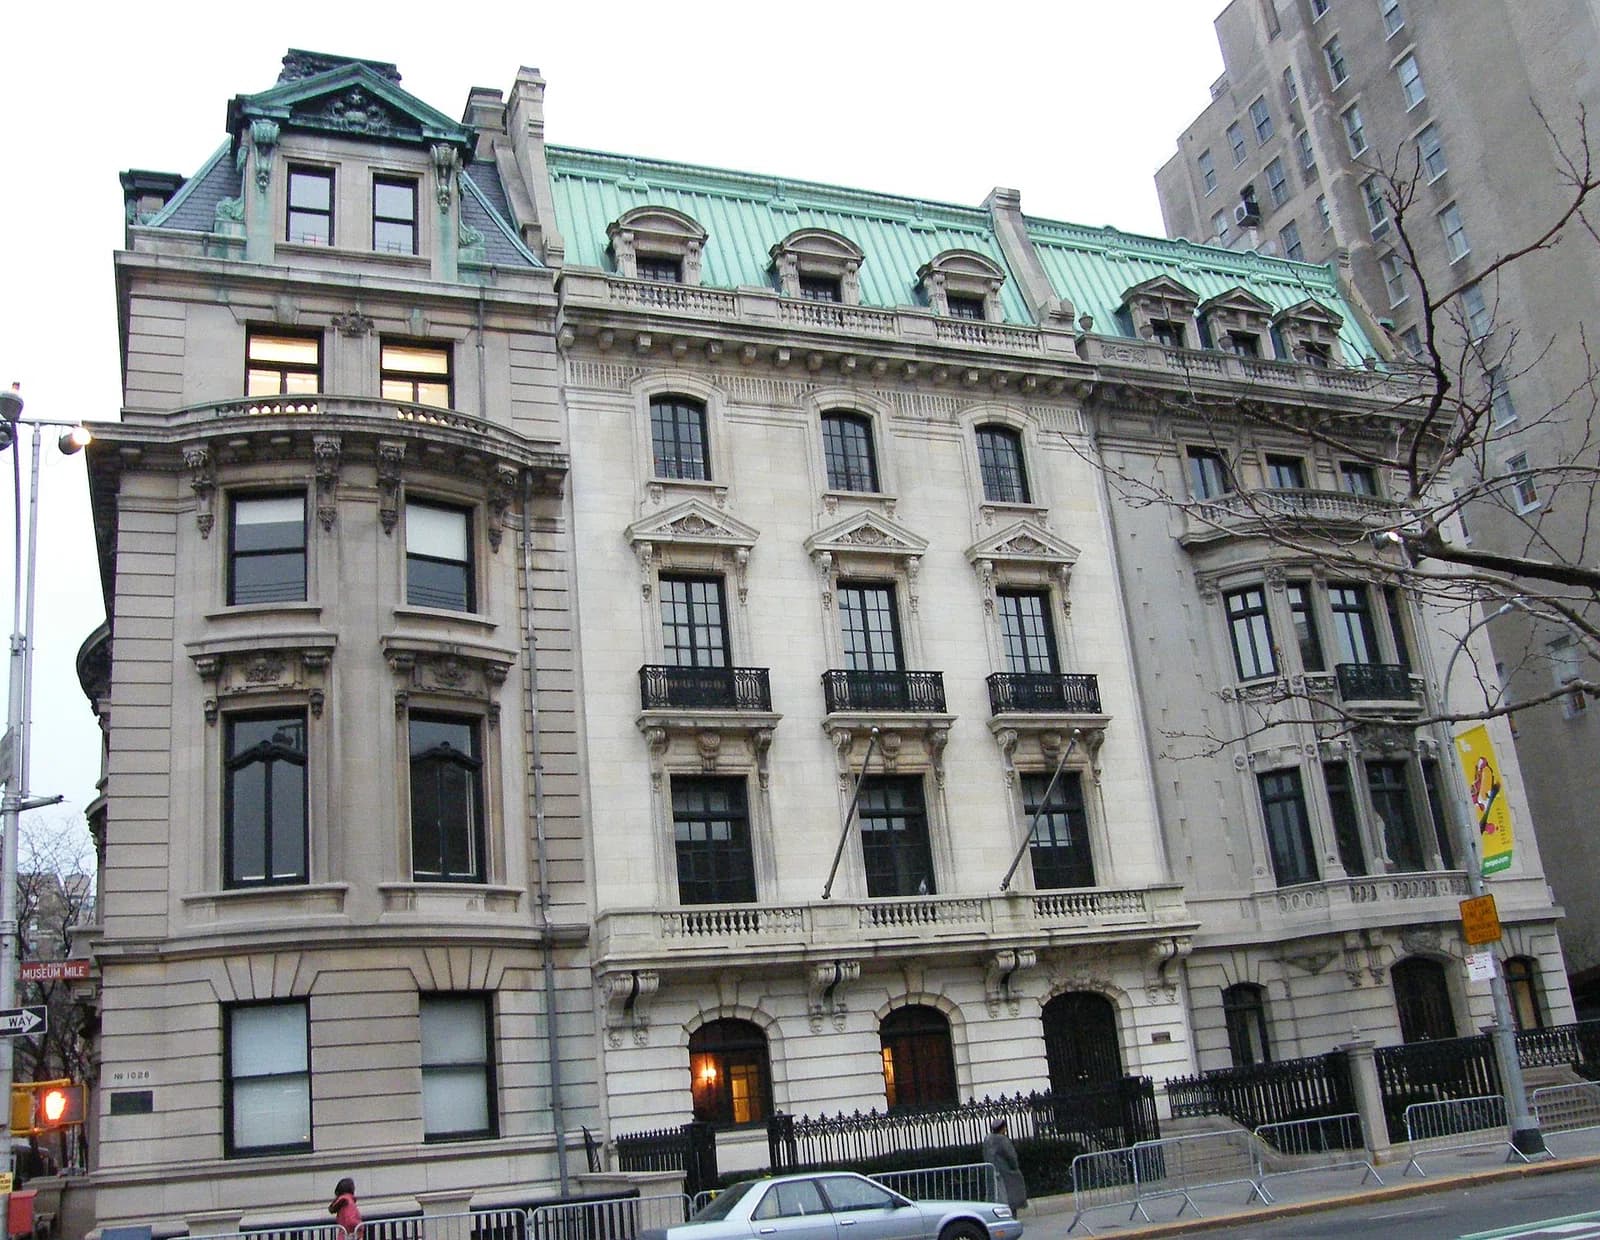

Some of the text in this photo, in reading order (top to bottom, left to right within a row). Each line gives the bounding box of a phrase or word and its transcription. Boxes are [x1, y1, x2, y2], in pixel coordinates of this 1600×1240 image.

[22, 966, 85, 980] MUSEUM MILE
[8, 1016, 33, 1027] WAY
